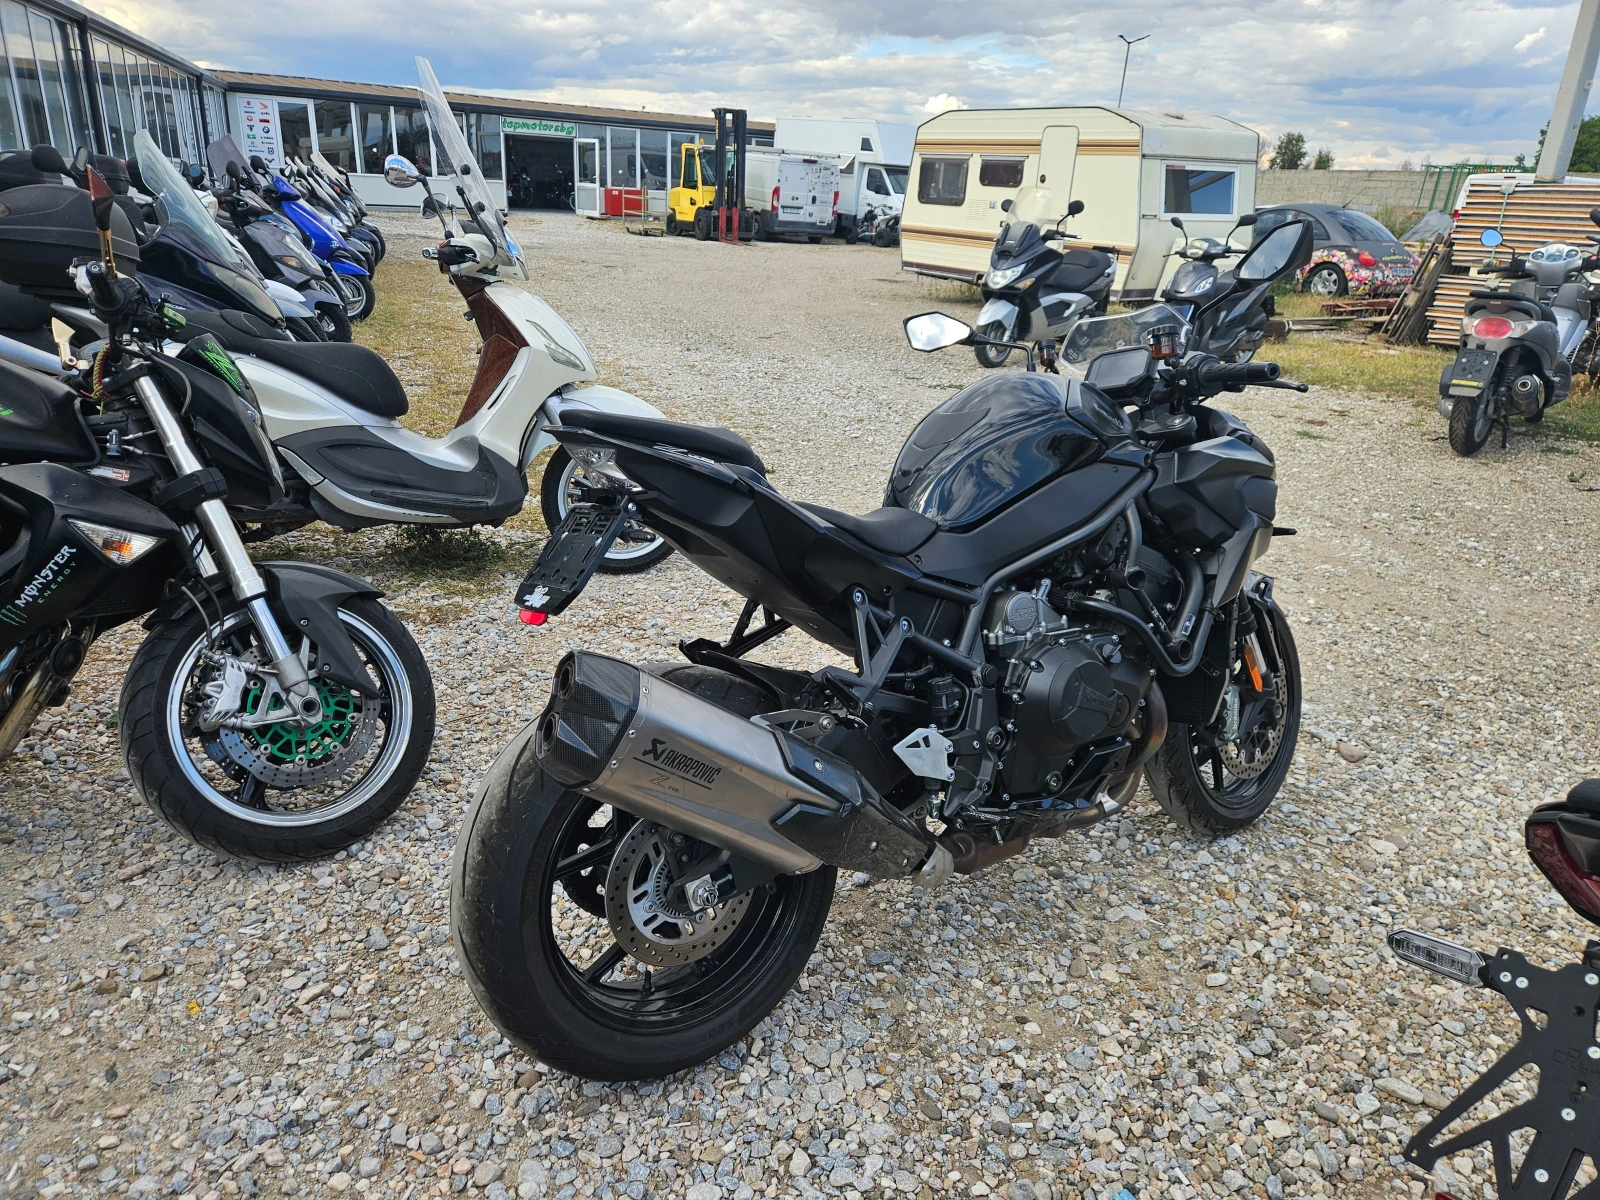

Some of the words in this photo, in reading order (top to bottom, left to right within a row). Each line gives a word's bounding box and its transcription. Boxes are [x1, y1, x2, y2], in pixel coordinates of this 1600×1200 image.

[502, 118, 574, 135] topmotorsbg
[15, 545, 77, 608] MONSTER
[38, 561, 76, 604] ENERGY
